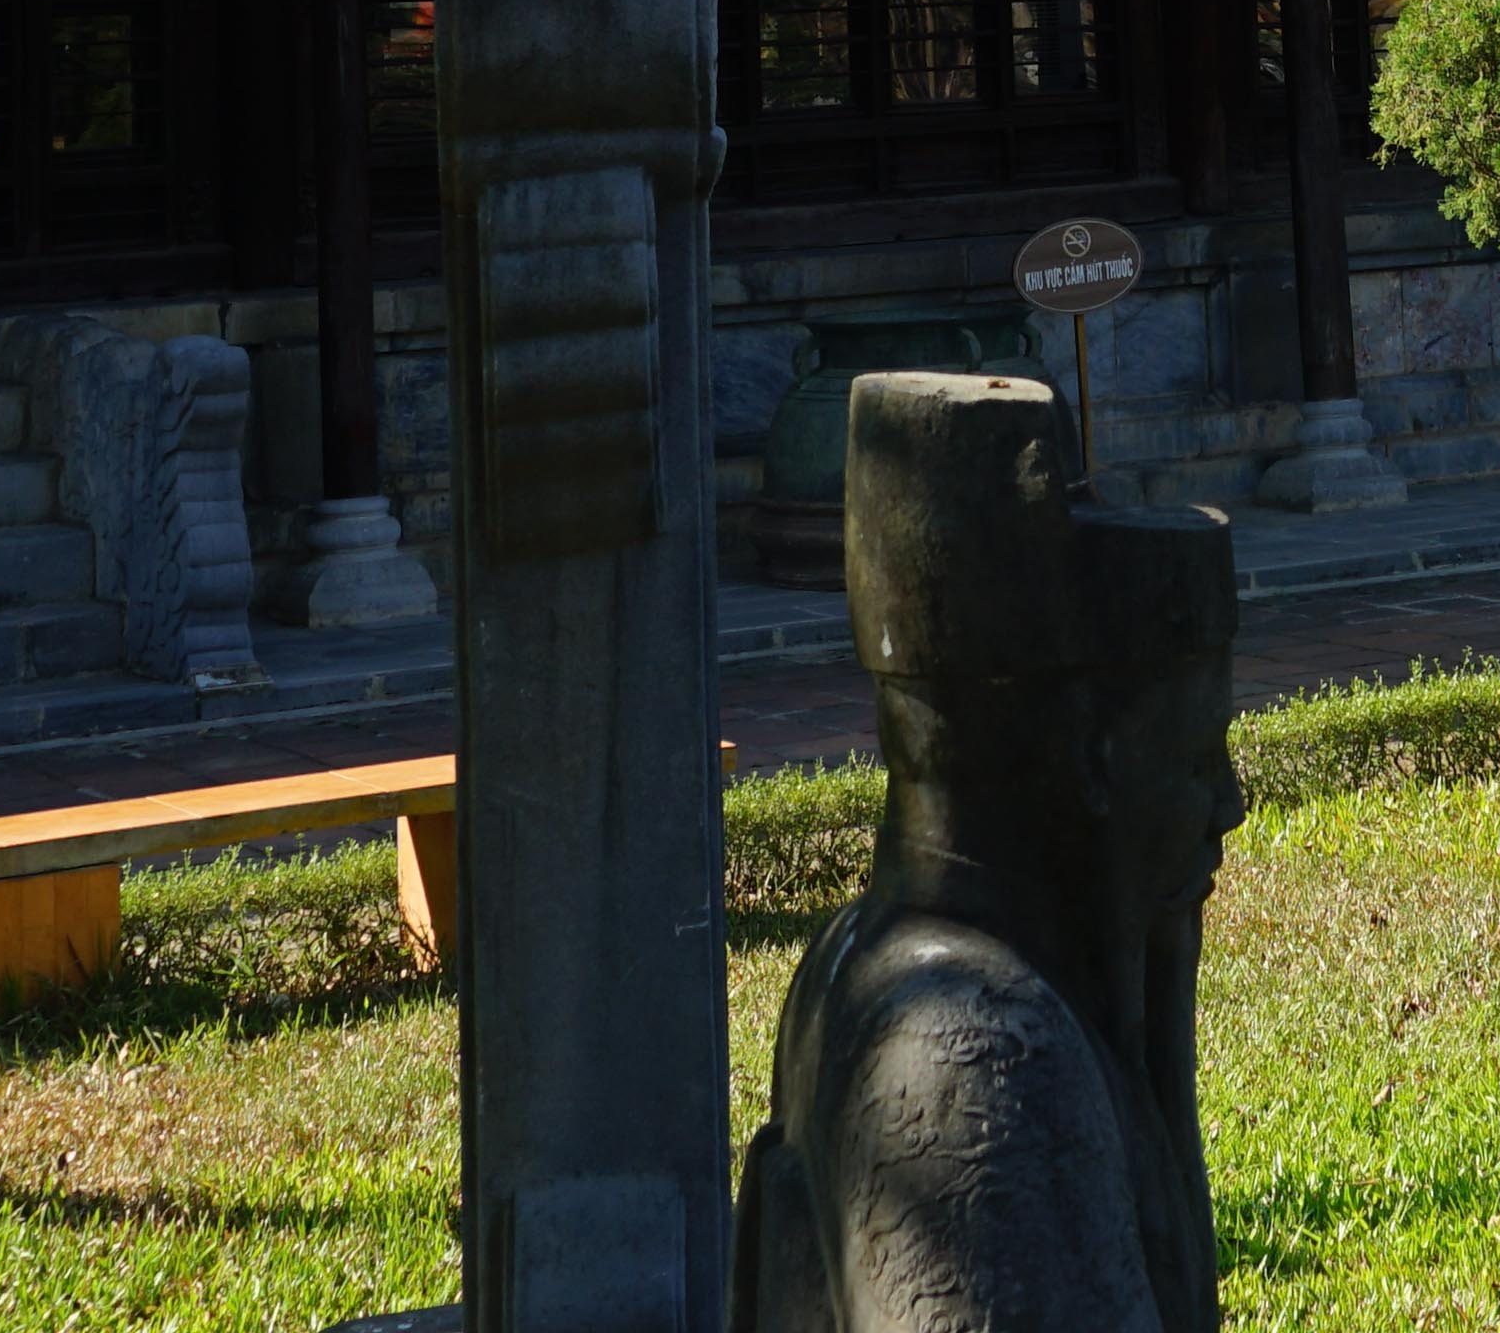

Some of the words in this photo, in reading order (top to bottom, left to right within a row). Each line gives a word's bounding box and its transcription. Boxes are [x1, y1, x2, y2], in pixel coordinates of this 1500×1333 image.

[1025, 271, 1044, 292] KHU
[1044, 266, 1063, 293] VỰC
[1064, 259, 1086, 286] CẤM
[1086, 259, 1103, 283] HÚT
[1104, 251, 1134, 280] THUỐC
